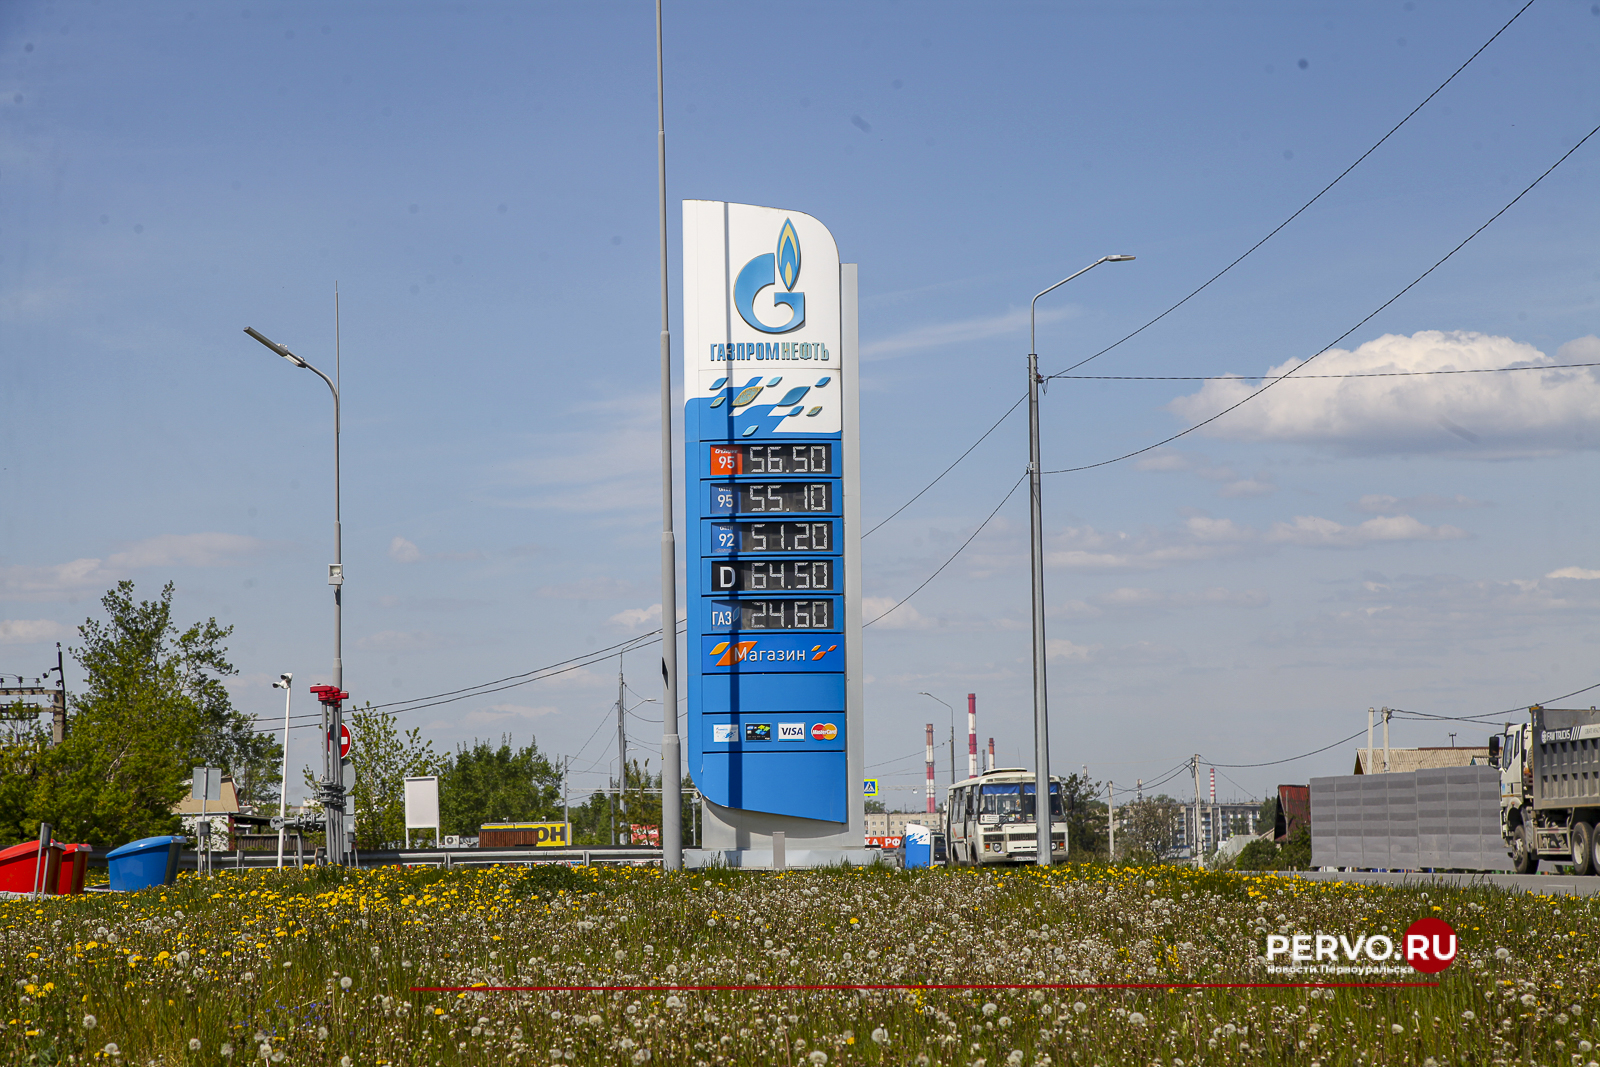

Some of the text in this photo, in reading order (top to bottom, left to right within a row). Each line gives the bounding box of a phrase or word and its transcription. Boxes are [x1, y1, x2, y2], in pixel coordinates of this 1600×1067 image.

[710, 342, 830, 361] ГАЗПРОМНЕФТЬ
[718, 445, 826, 473] 95 56.50
[717, 484, 826, 512] 95 55.10
[718, 523, 828, 550] 92 51.20
[720, 562, 828, 589] D 64.50
[712, 601, 828, 628] ГАЗ 24.60
[734, 646, 806, 662] Магазин
[781, 727, 803, 736] VISA
